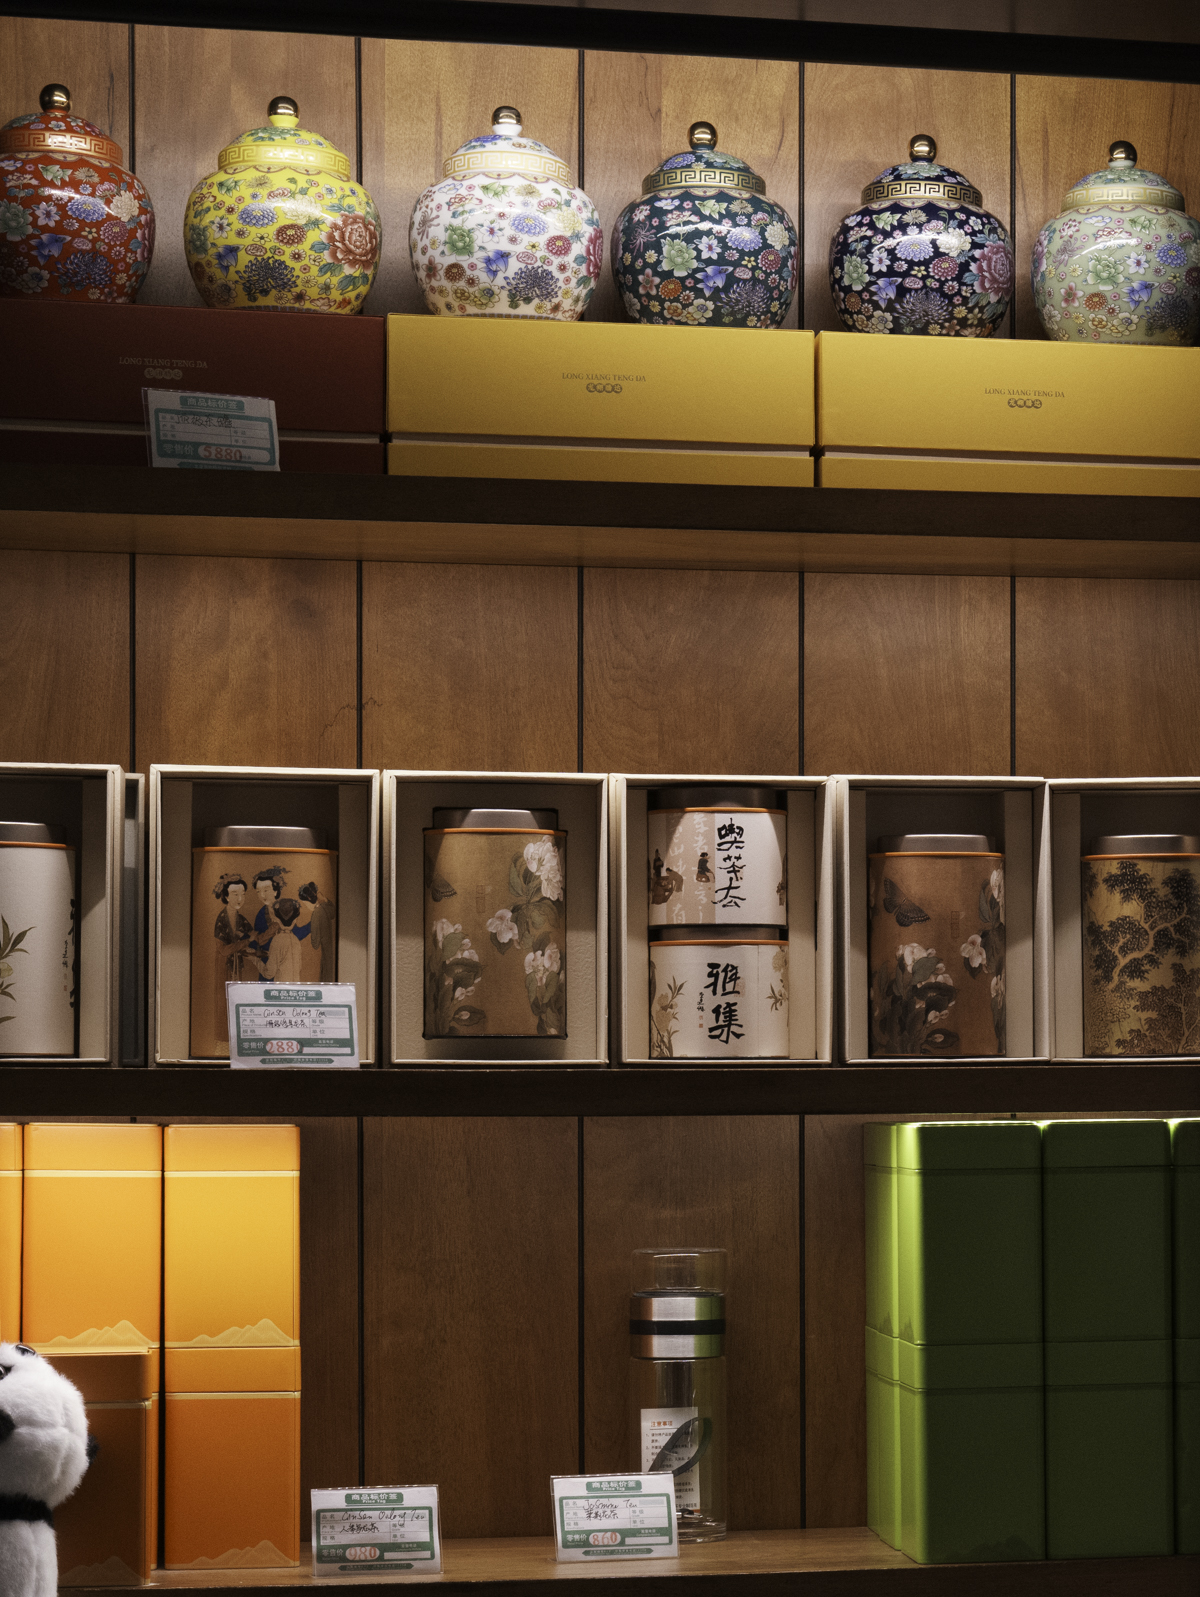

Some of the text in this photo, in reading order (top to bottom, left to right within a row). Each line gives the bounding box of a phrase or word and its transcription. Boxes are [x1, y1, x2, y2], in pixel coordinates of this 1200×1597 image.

[119, 357, 142, 365] LONG
[144, 358, 170, 366] XIANG
[172, 360, 195, 368] TENG
[562, 372, 584, 380] LONG
[586, 373, 611, 381] XIANG
[613, 374, 634, 382] TENG
[187, 398, 238, 409] 商品标价签
[163, 443, 194, 456] 零售价
[203, 445, 243, 461] 5880
[703, 962, 746, 1045] 雅集
[242, 1041, 264, 1049] 零售价
[650, 1420, 673, 1428] 注意事项
[351, 1493, 398, 1501] 商品标价签
[585, 1509, 619, 1521] 茉莉花茶
[566, 1533, 588, 1541] 零售价
[592, 1531, 618, 1546] 860
[322, 1549, 344, 1557] 零售价
[348, 1546, 377, 1560] 980
